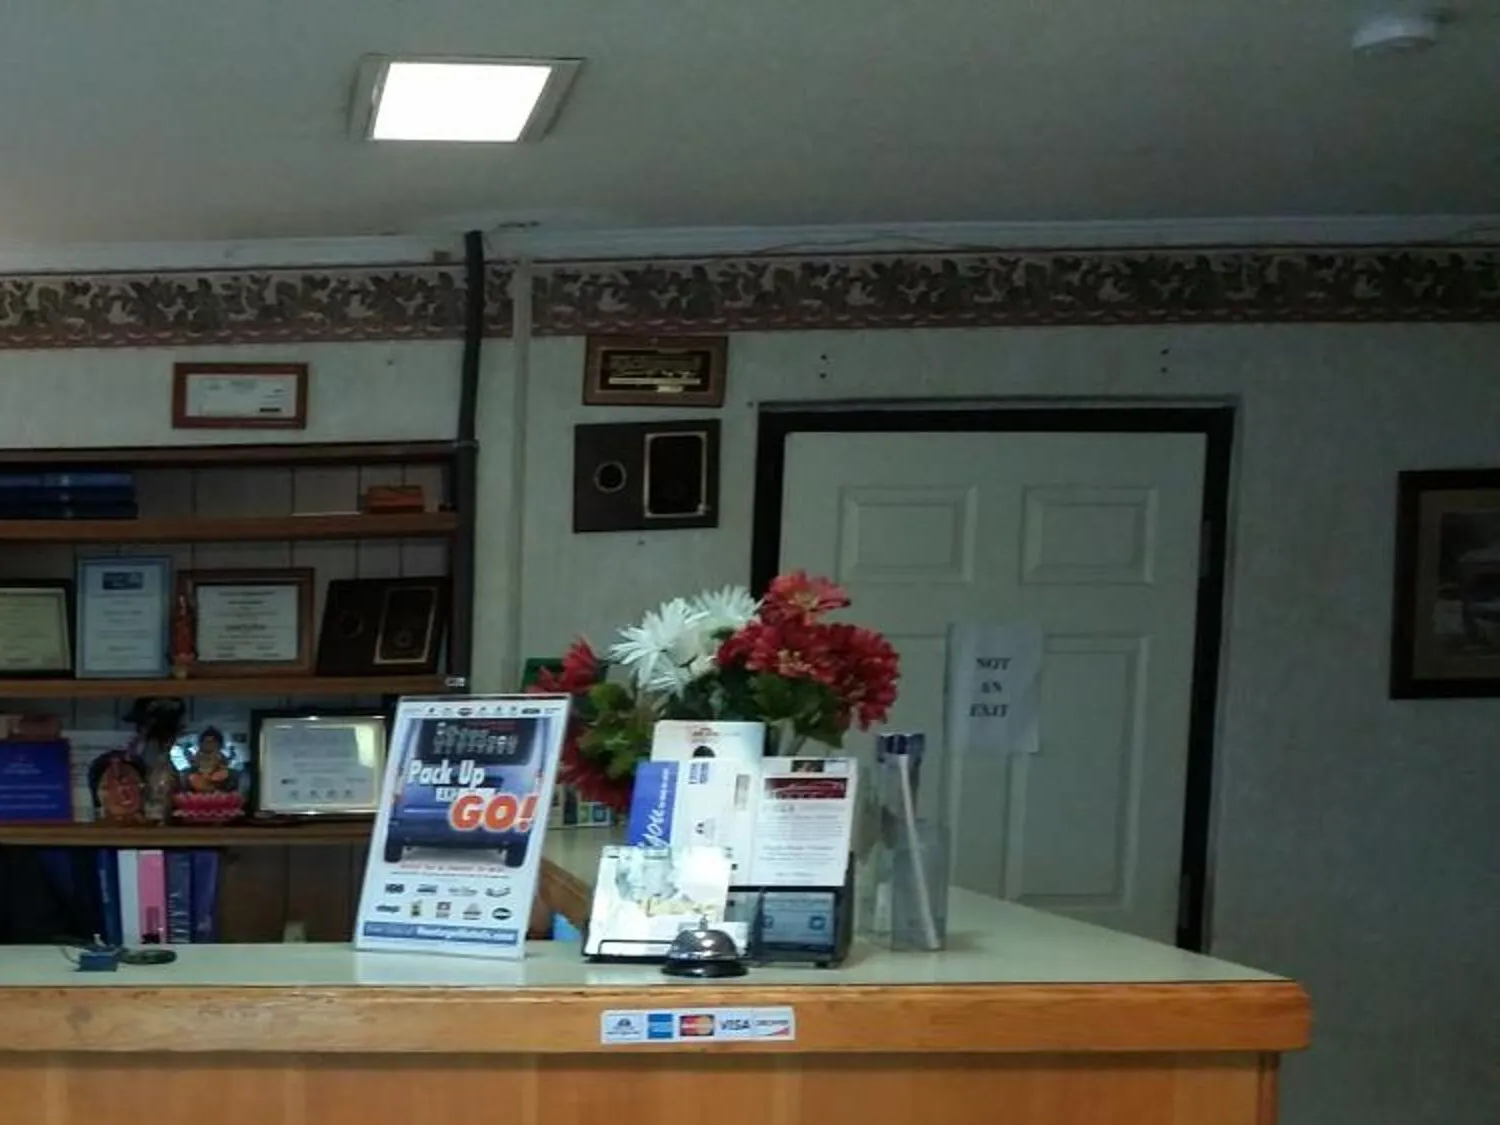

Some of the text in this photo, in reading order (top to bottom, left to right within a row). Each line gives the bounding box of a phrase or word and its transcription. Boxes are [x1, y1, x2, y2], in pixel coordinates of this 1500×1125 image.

[407, 758, 485, 790] Pack Up
[449, 792, 541, 833] GO!
